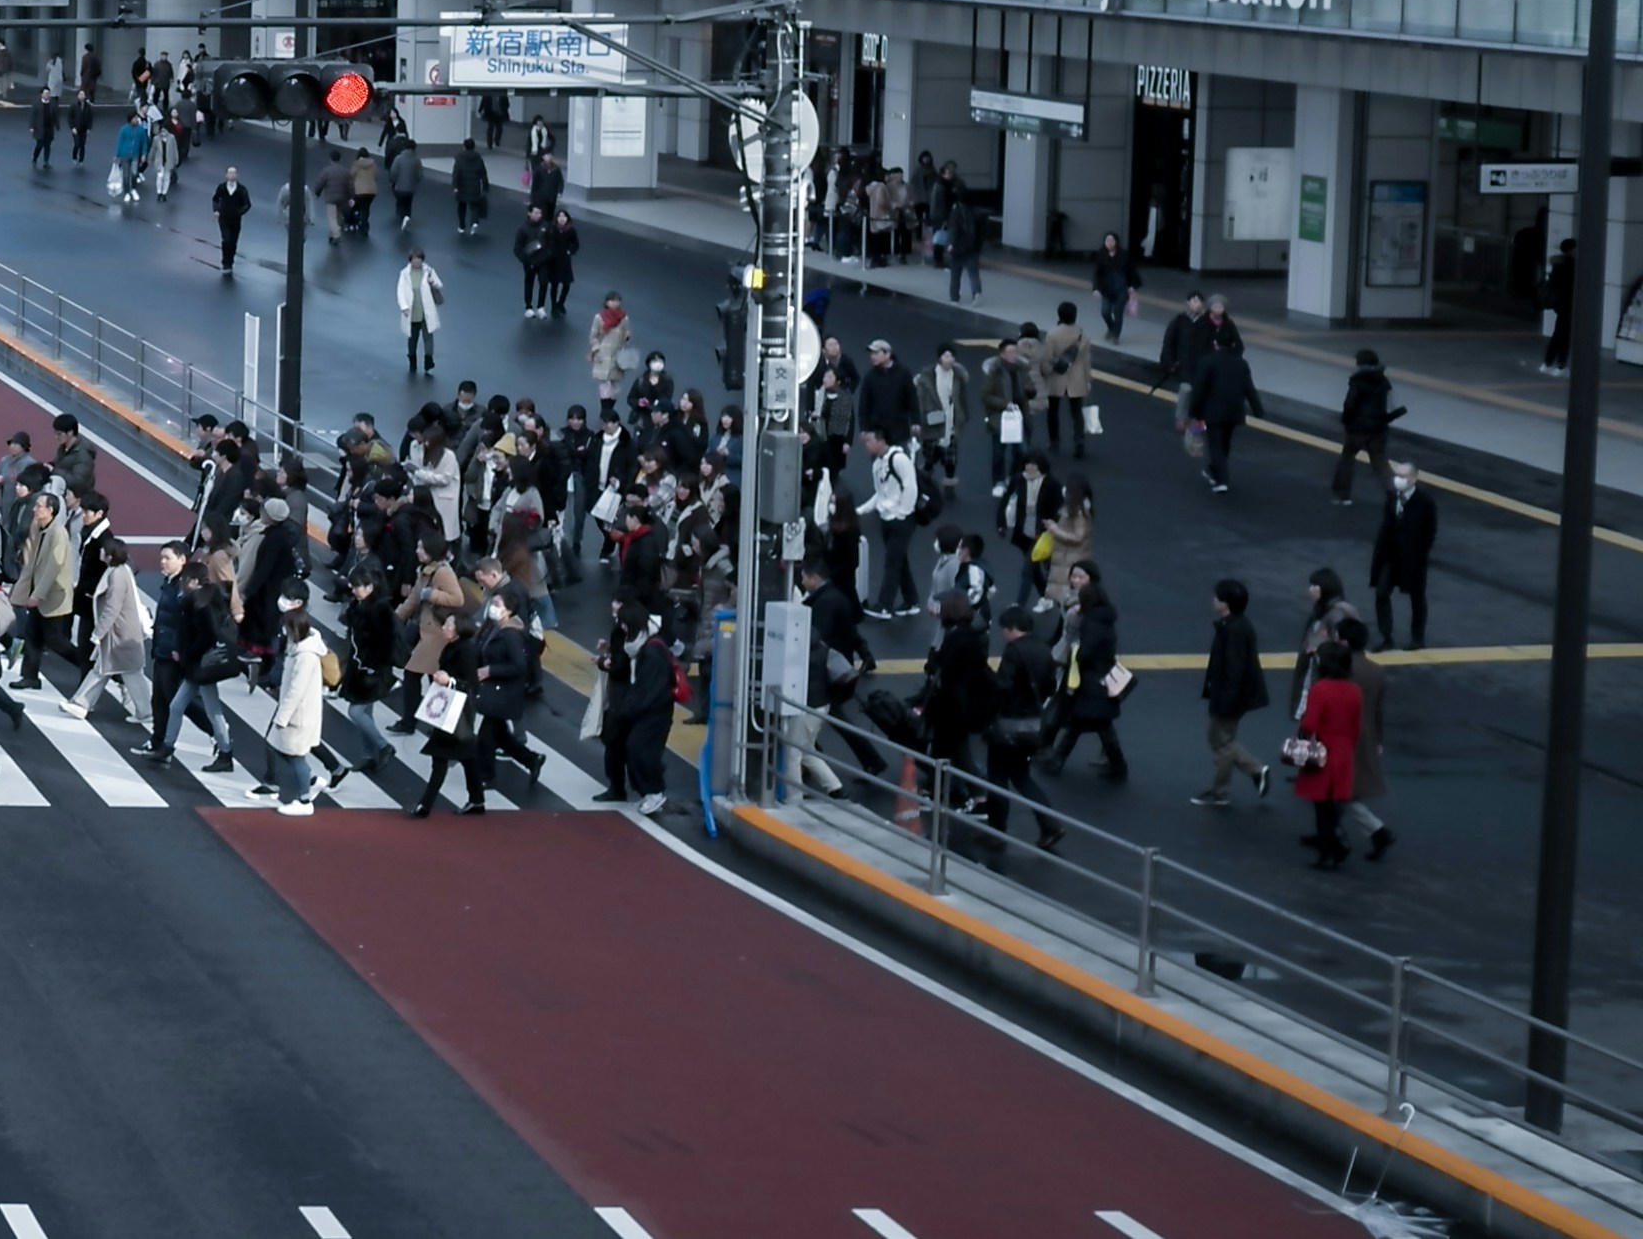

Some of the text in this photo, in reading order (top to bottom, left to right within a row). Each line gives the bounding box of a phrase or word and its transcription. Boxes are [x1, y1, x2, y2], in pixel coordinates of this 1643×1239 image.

[465, 28, 612, 58] 新宿駅南口
[487, 58, 589, 76] Shinjuku Sta.
[1137, 64, 1191, 101] PIZZERIA
